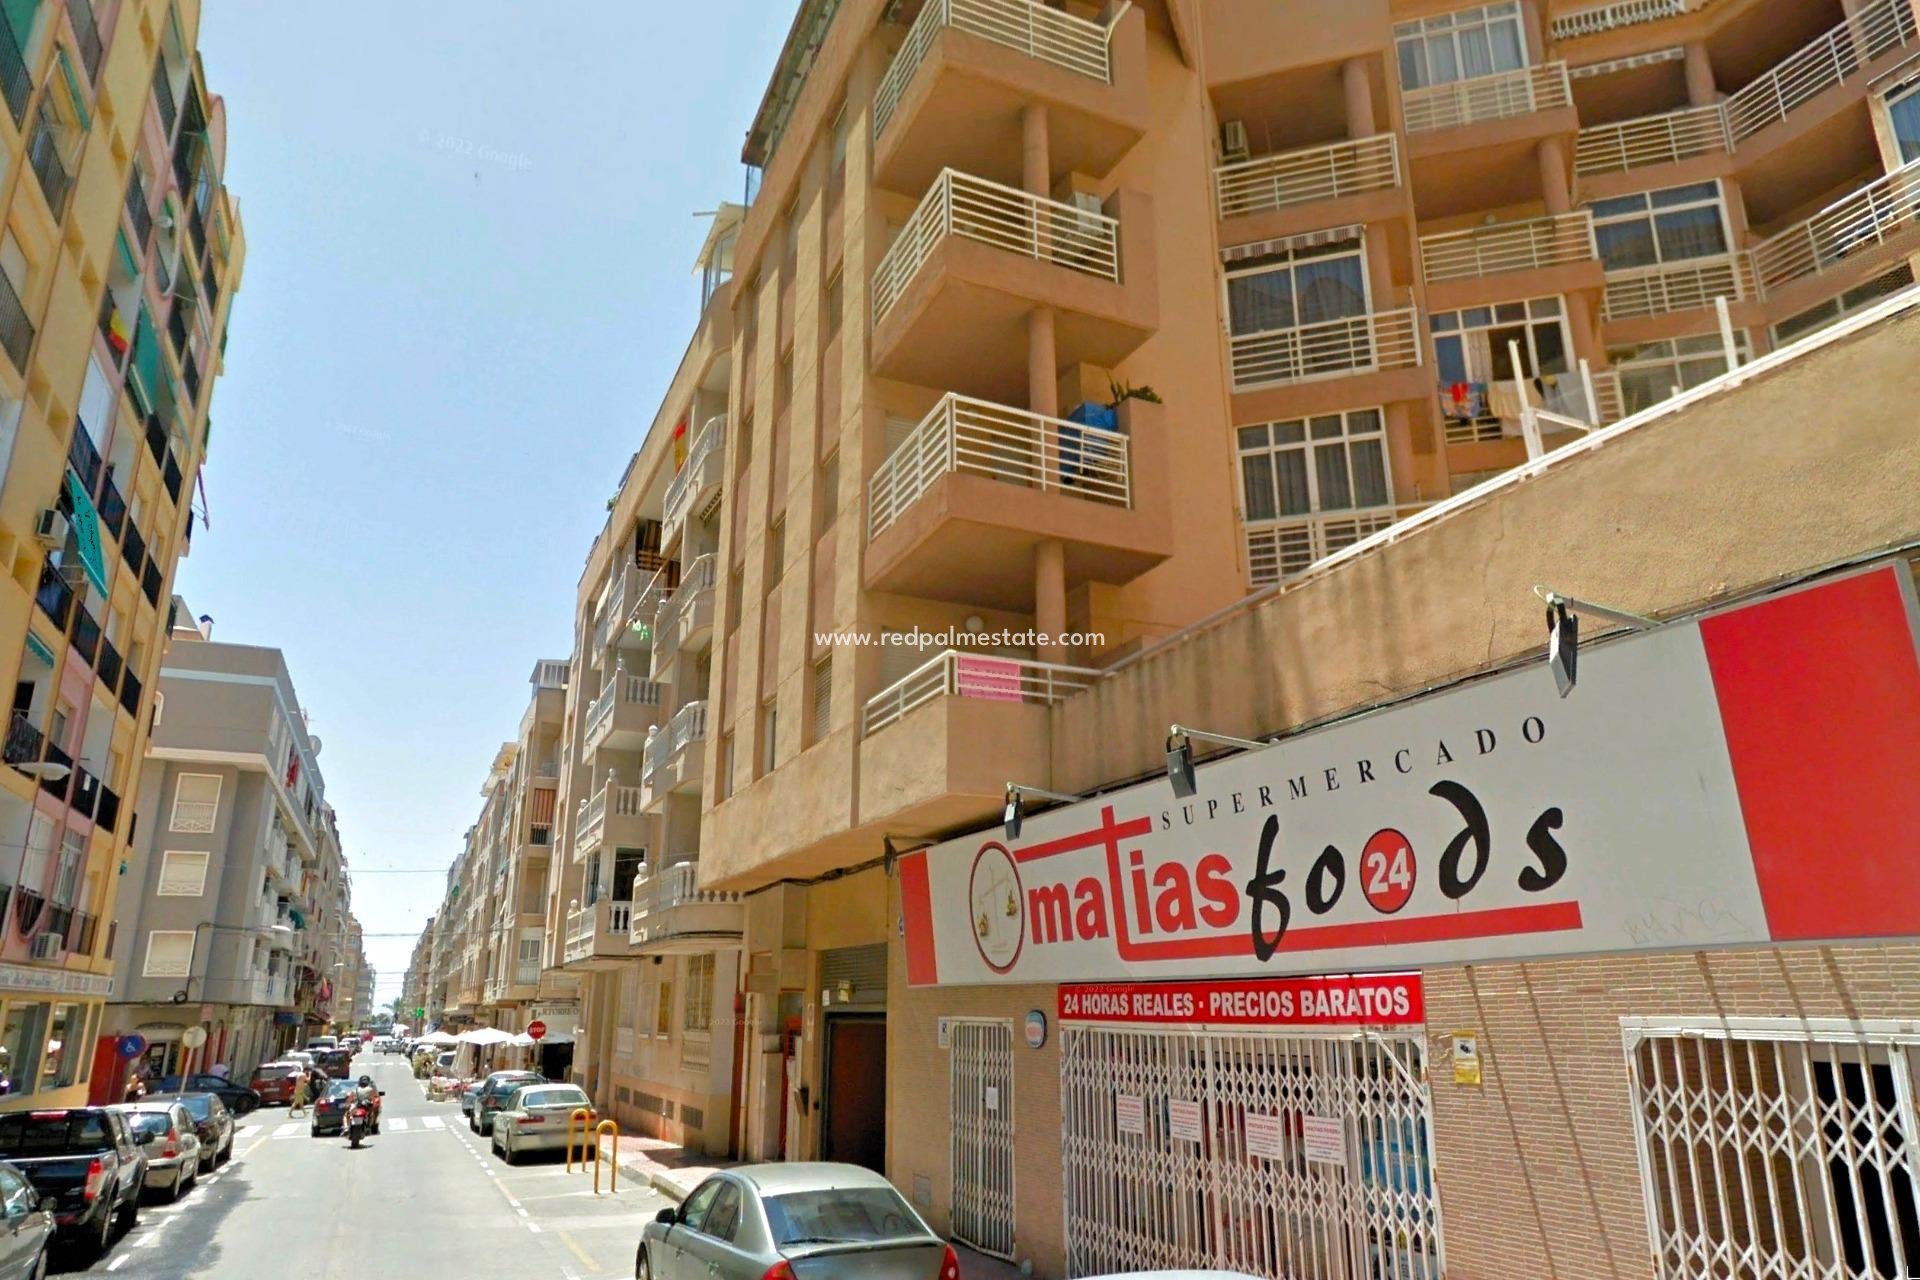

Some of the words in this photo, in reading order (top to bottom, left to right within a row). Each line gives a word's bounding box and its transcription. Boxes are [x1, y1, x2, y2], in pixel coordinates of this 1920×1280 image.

[1162, 716, 1546, 830] SUPERMERCADO
[1028, 805, 1241, 962] matias
[1064, 993, 1079, 1014] 24
[1082, 993, 1129, 1016] HORAS
[1132, 992, 1195, 1017] REALES
[1209, 990, 1294, 1018] PRECIOS
[1300, 986, 1410, 1017] BARATOS
